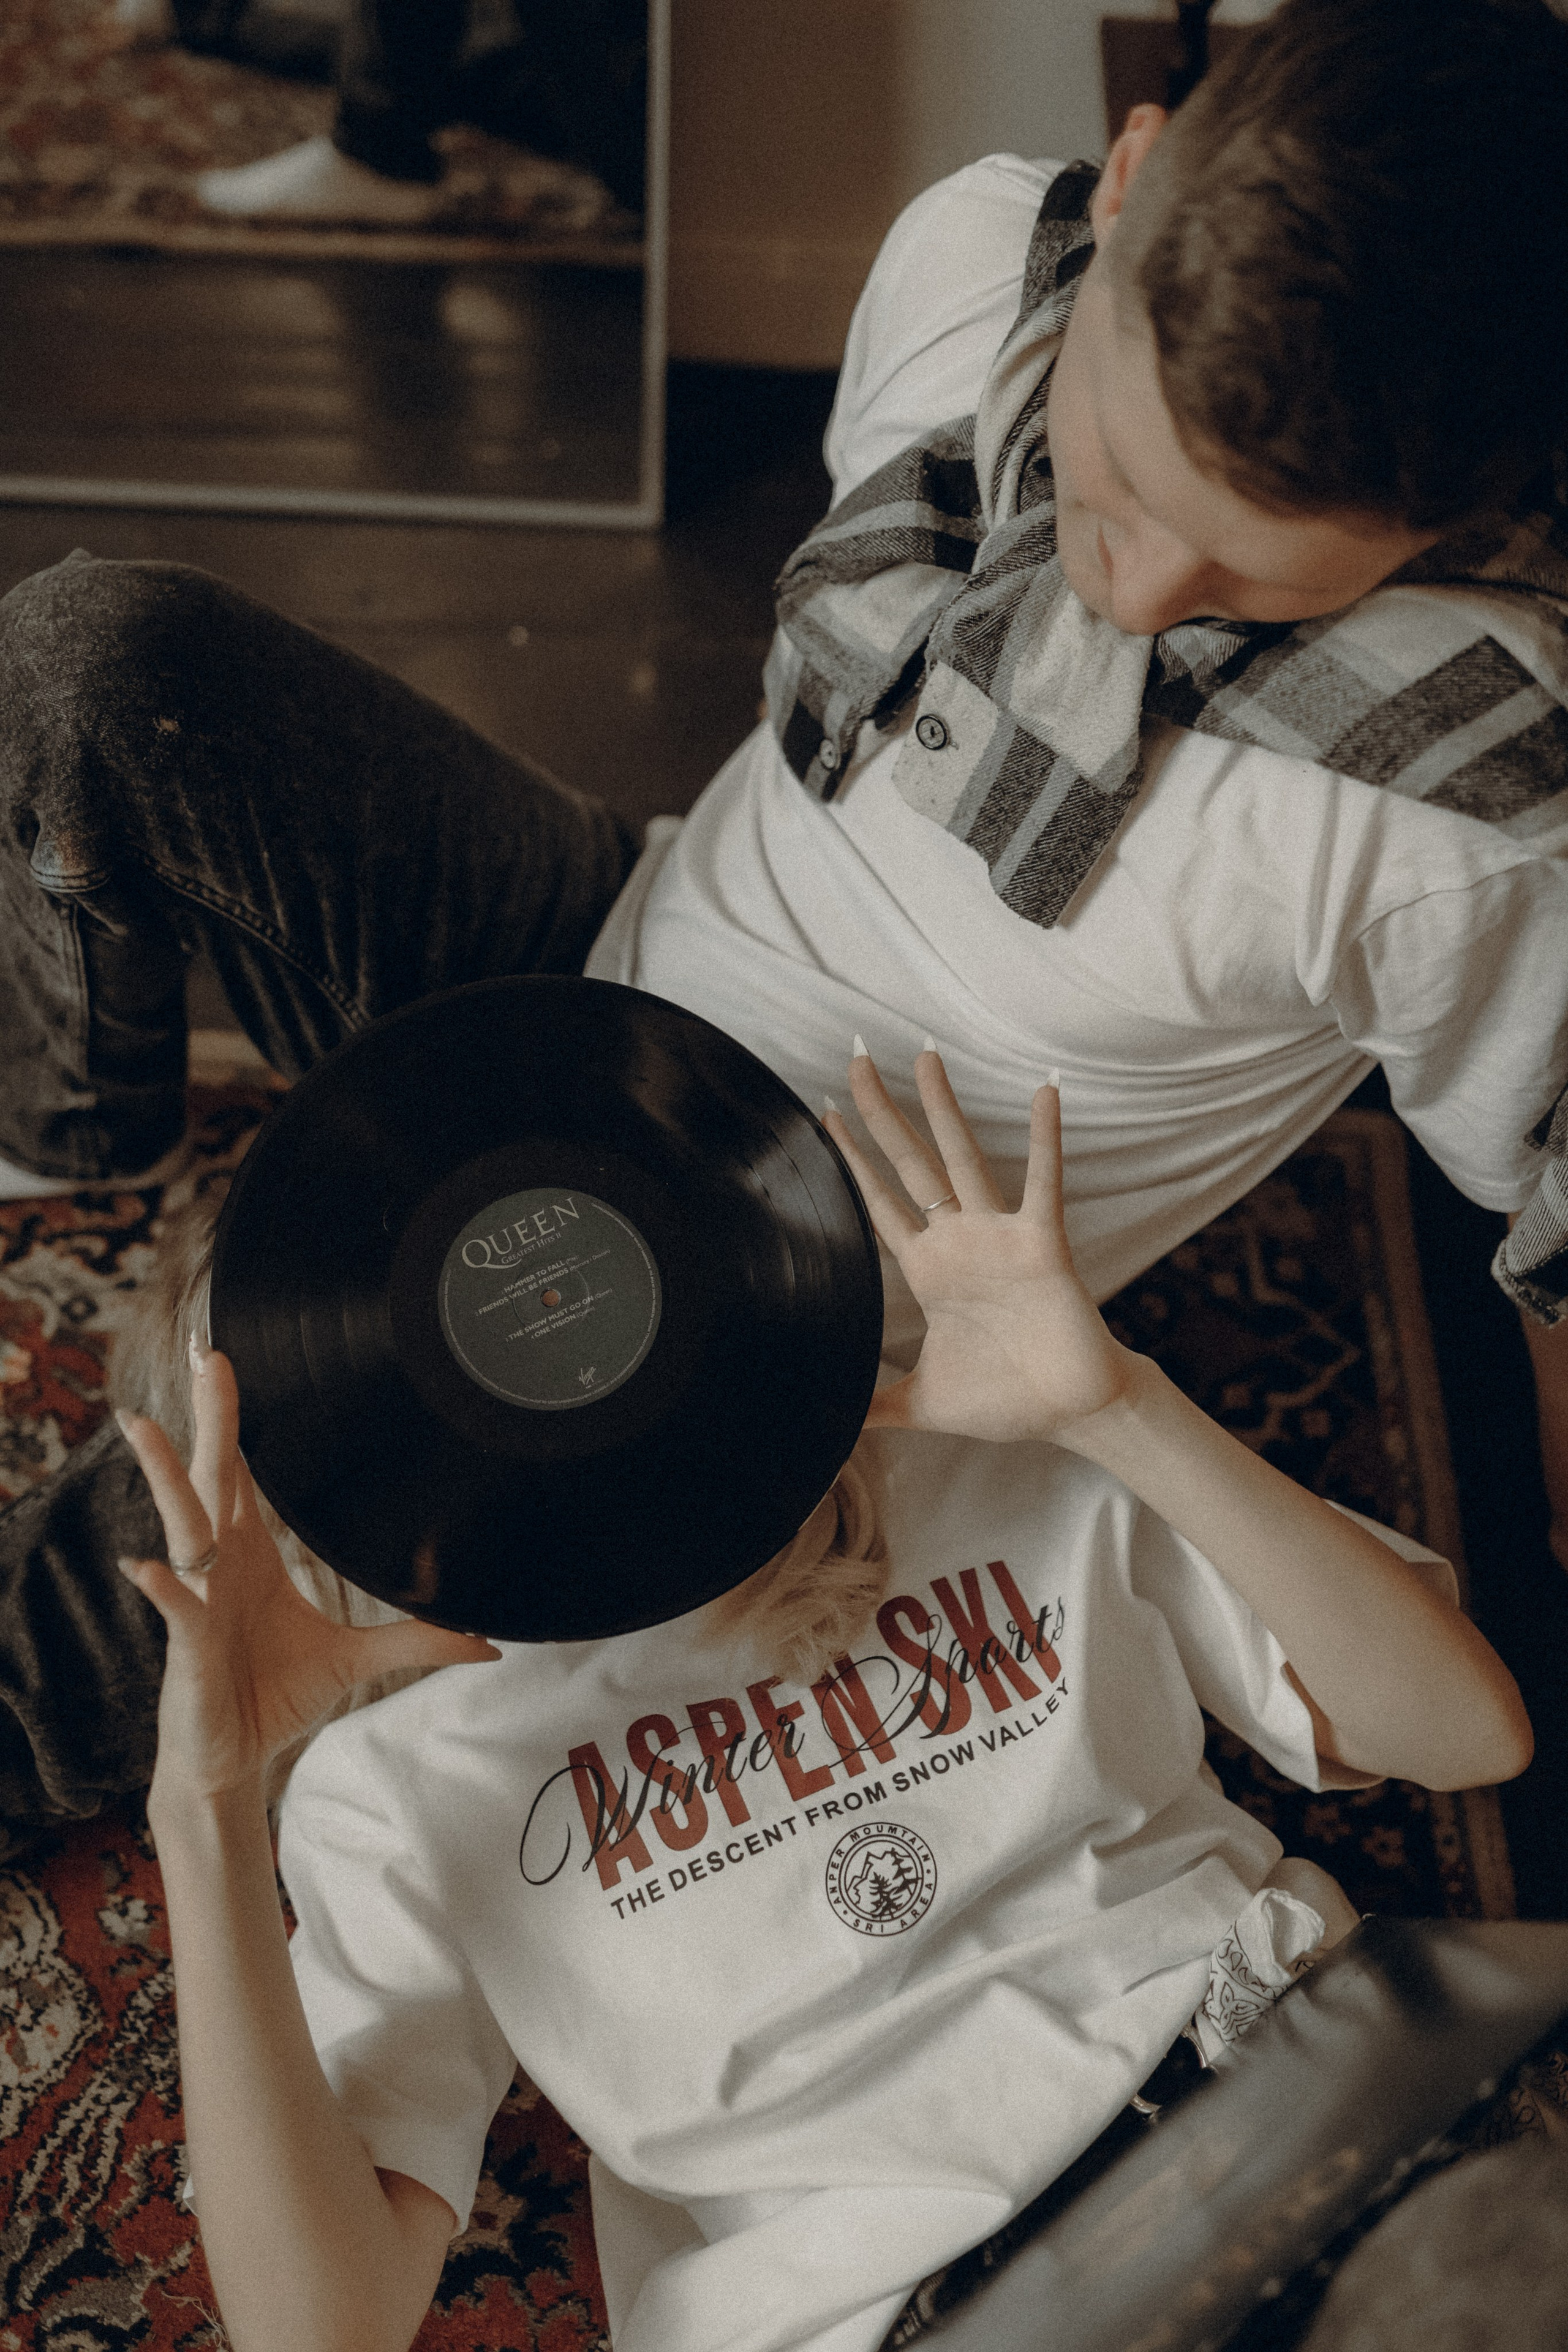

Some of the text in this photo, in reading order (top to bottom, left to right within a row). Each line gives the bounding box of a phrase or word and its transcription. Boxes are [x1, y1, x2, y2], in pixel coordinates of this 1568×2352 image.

[462, 1197, 579, 1268] QUEEN
[501, 1245, 535, 1264] GREATEST
[536, 1237, 555, 1249] HITS
[478, 1296, 508, 1314] FRIENDS
[509, 1287, 527, 1299] WILL
[528, 1282, 538, 1291] BE
[538, 1267, 569, 1286] FRIENDS
[503, 1274, 535, 1293] HAMMER
[536, 1268, 547, 1277] TO
[547, 1260, 565, 1272] FALL
[508, 1329, 524, 1340] THE
[524, 1317, 548, 1332] SHOW
[548, 1308, 568, 1321] MUST
[569, 1302, 581, 1311] GO
[581, 1295, 594, 1305] ON
[533, 1325, 551, 1338] ONE
[551, 1314, 576, 1329] VISION
[520, 1596, 1066, 1886] Winter Sports
[568, 1560, 1063, 1891] ASPEN SKI
[610, 1676, 1071, 1920] THE DESCENT FROM SNOW VALLEY
[853, 1883, 933, 1932] SRI AREA
